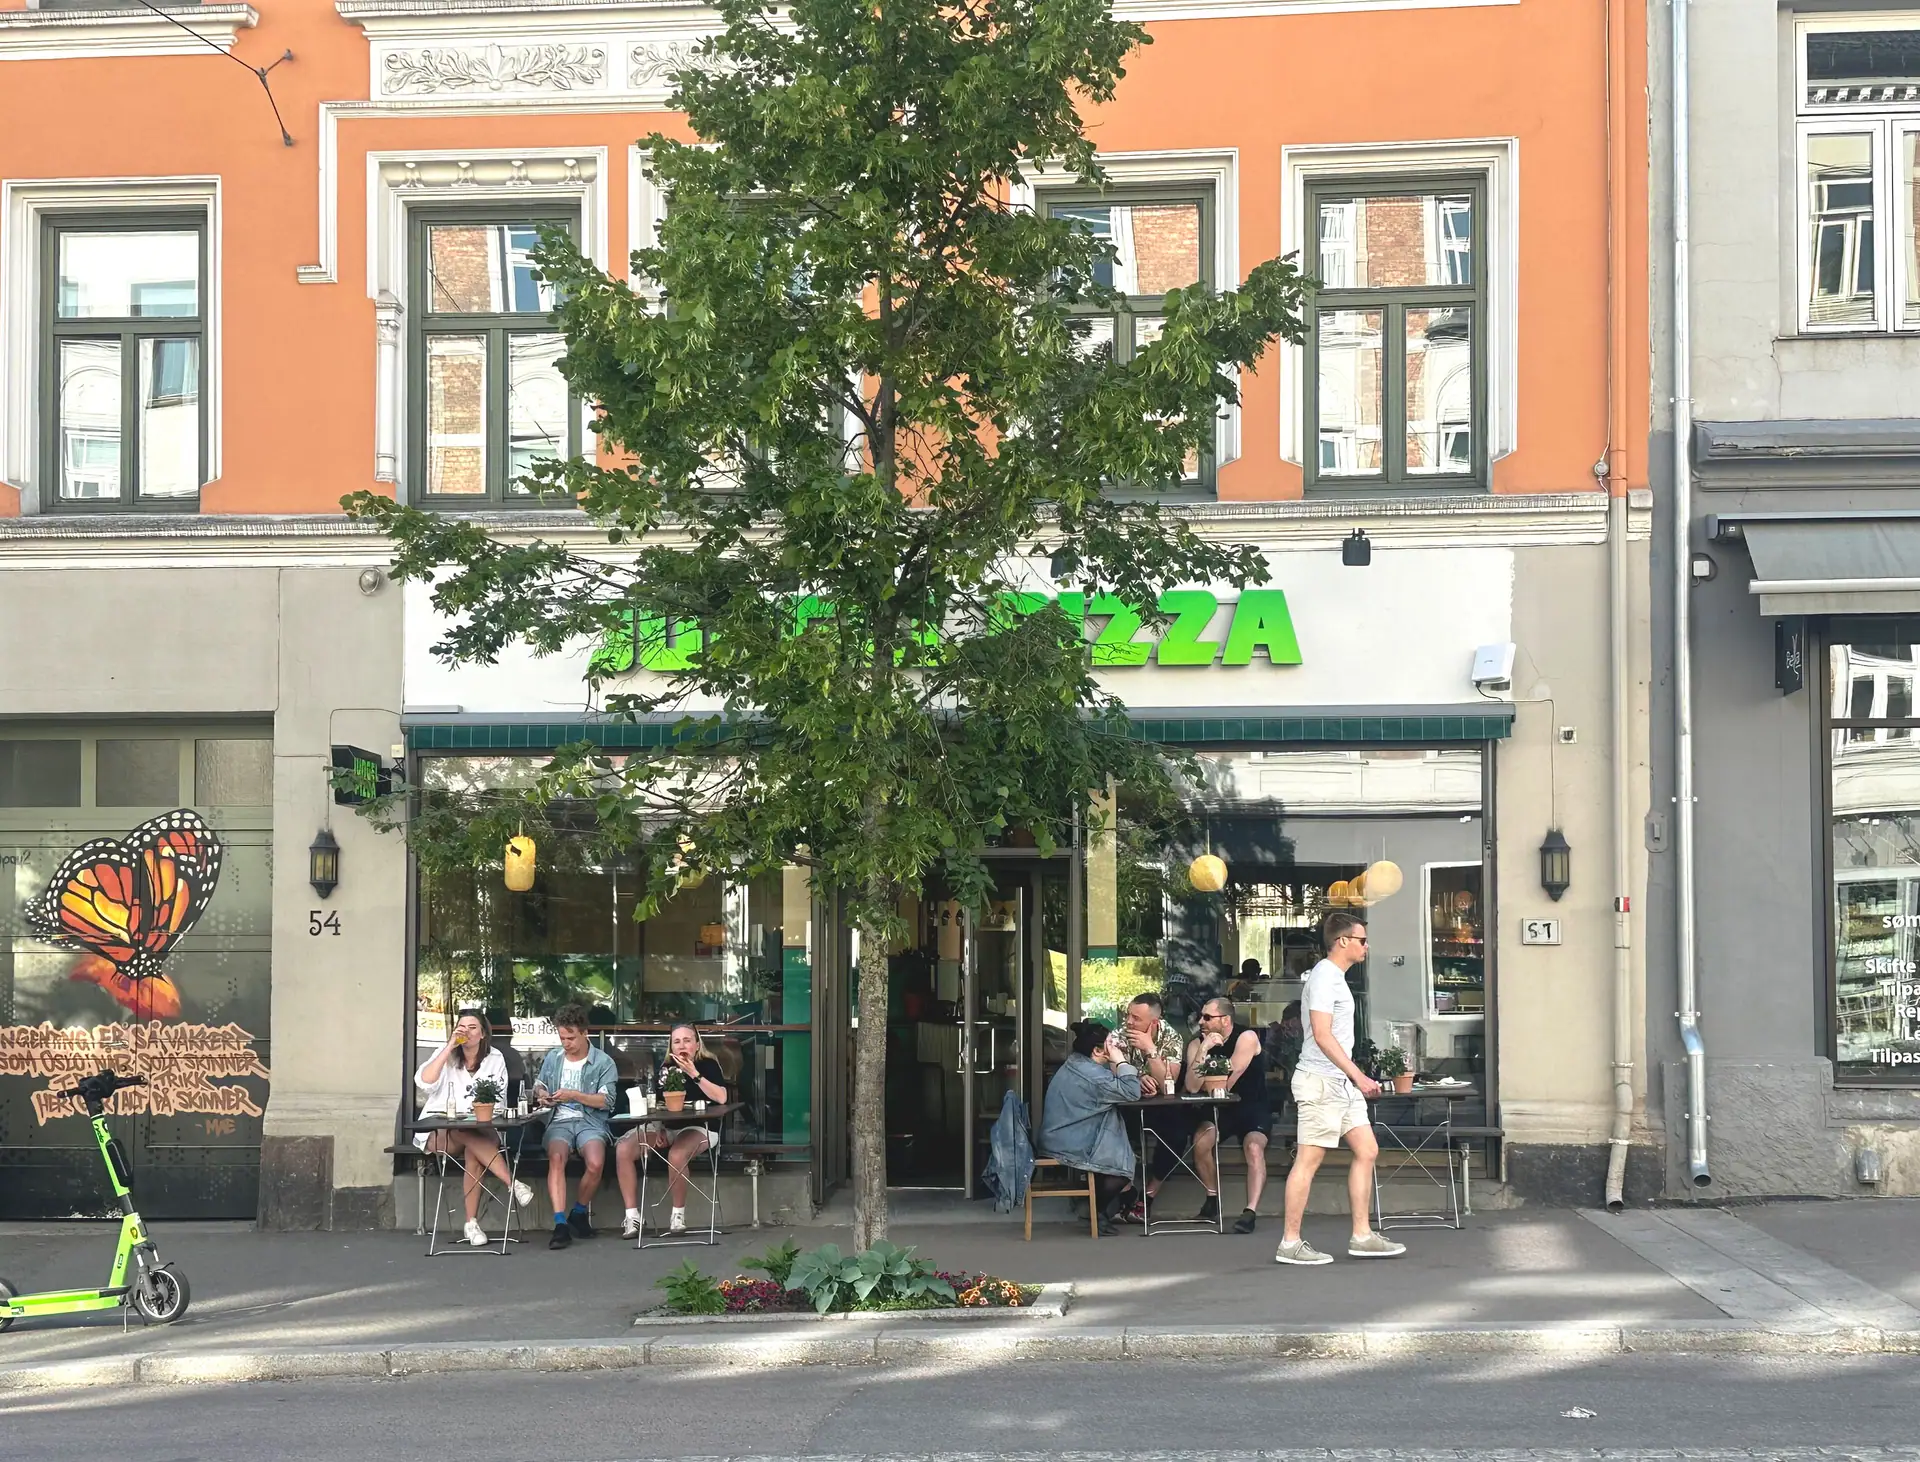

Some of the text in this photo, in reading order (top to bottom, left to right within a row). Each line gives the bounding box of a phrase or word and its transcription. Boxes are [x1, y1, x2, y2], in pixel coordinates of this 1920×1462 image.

[988, 589, 1302, 666] PIZZA
[309, 910, 341, 936] 54
[1865, 957, 1916, 974] Skifte
[0, 1050, 37, 1073] SOM
[138, 1052, 181, 1074] SOLA
[154, 1071, 215, 1091] TRIKK
[152, 1087, 172, 1112] PÅ
[176, 1087, 258, 1112] SKINNER
